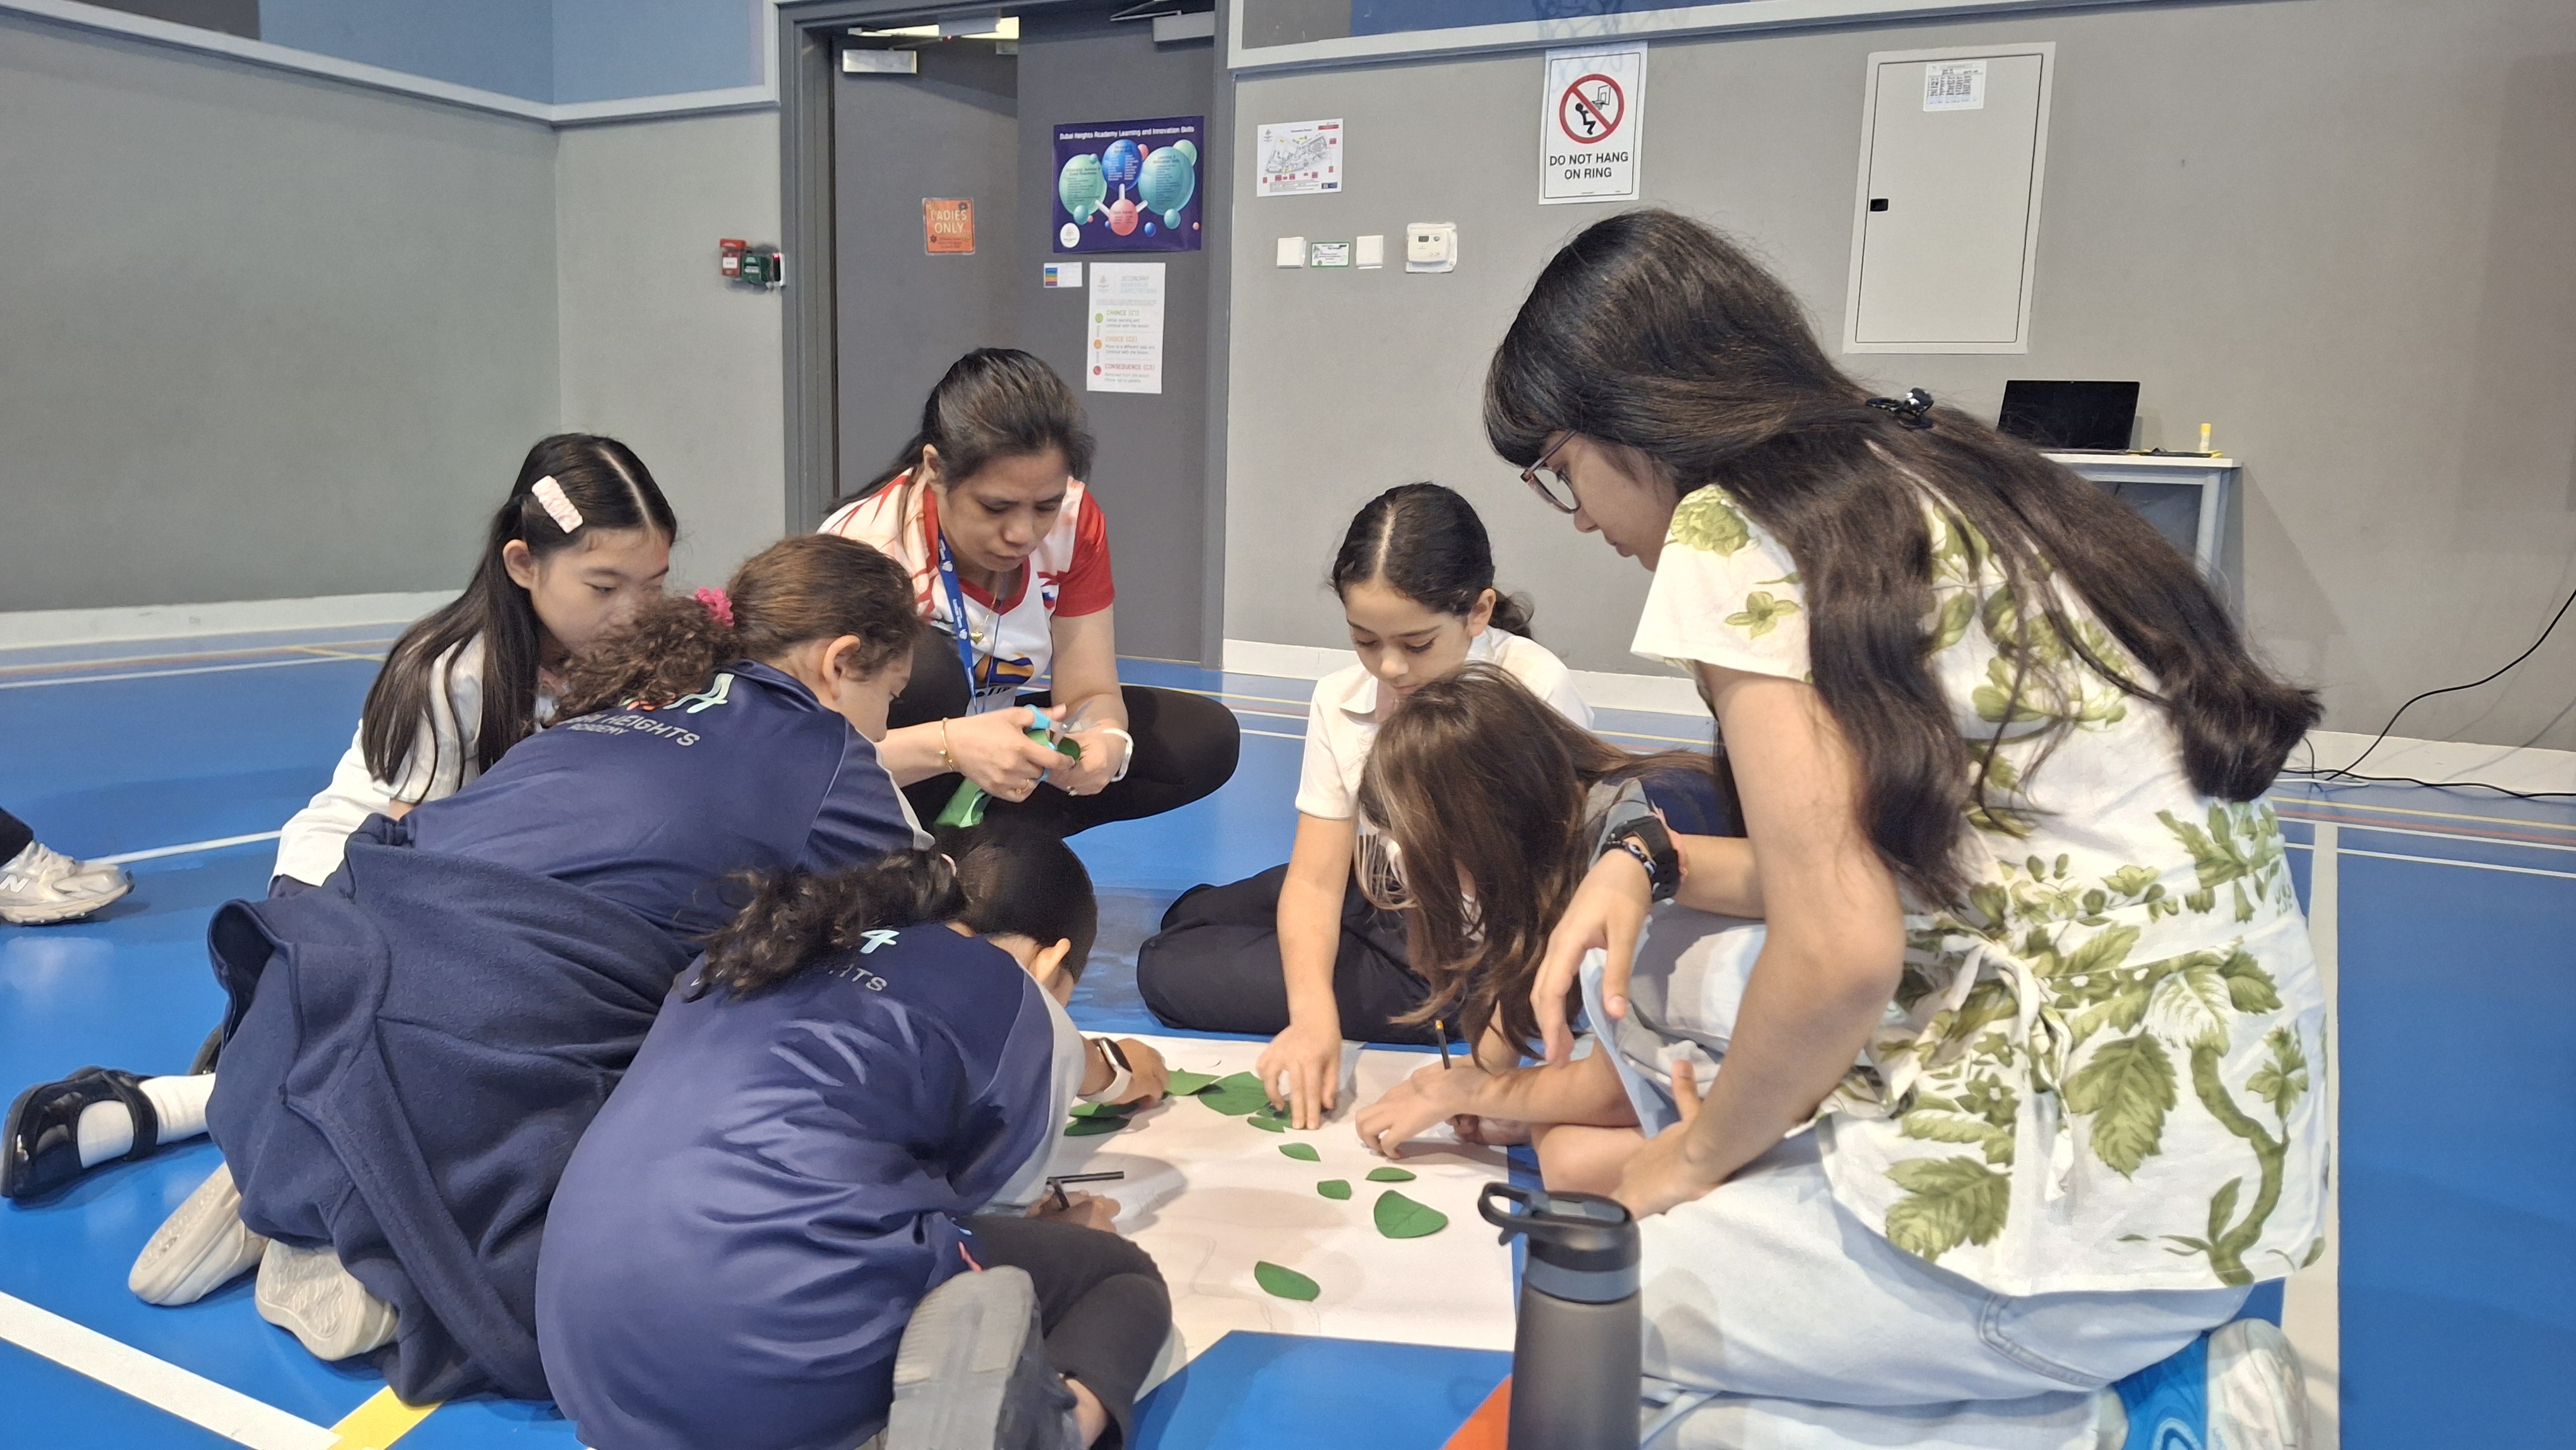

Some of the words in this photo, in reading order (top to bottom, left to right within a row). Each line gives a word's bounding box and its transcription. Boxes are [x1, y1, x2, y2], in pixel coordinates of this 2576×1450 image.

[1549, 155, 1566, 165] DO
[1569, 153, 1592, 164] NOT
[1595, 152, 1628, 163] HANG
[1565, 169, 1580, 179] ON
[1584, 167, 1612, 178] RING
[931, 209, 967, 221] LADIES
[934, 222, 964, 234] ONLY
[602, 715, 701, 746] HEIGHTS
